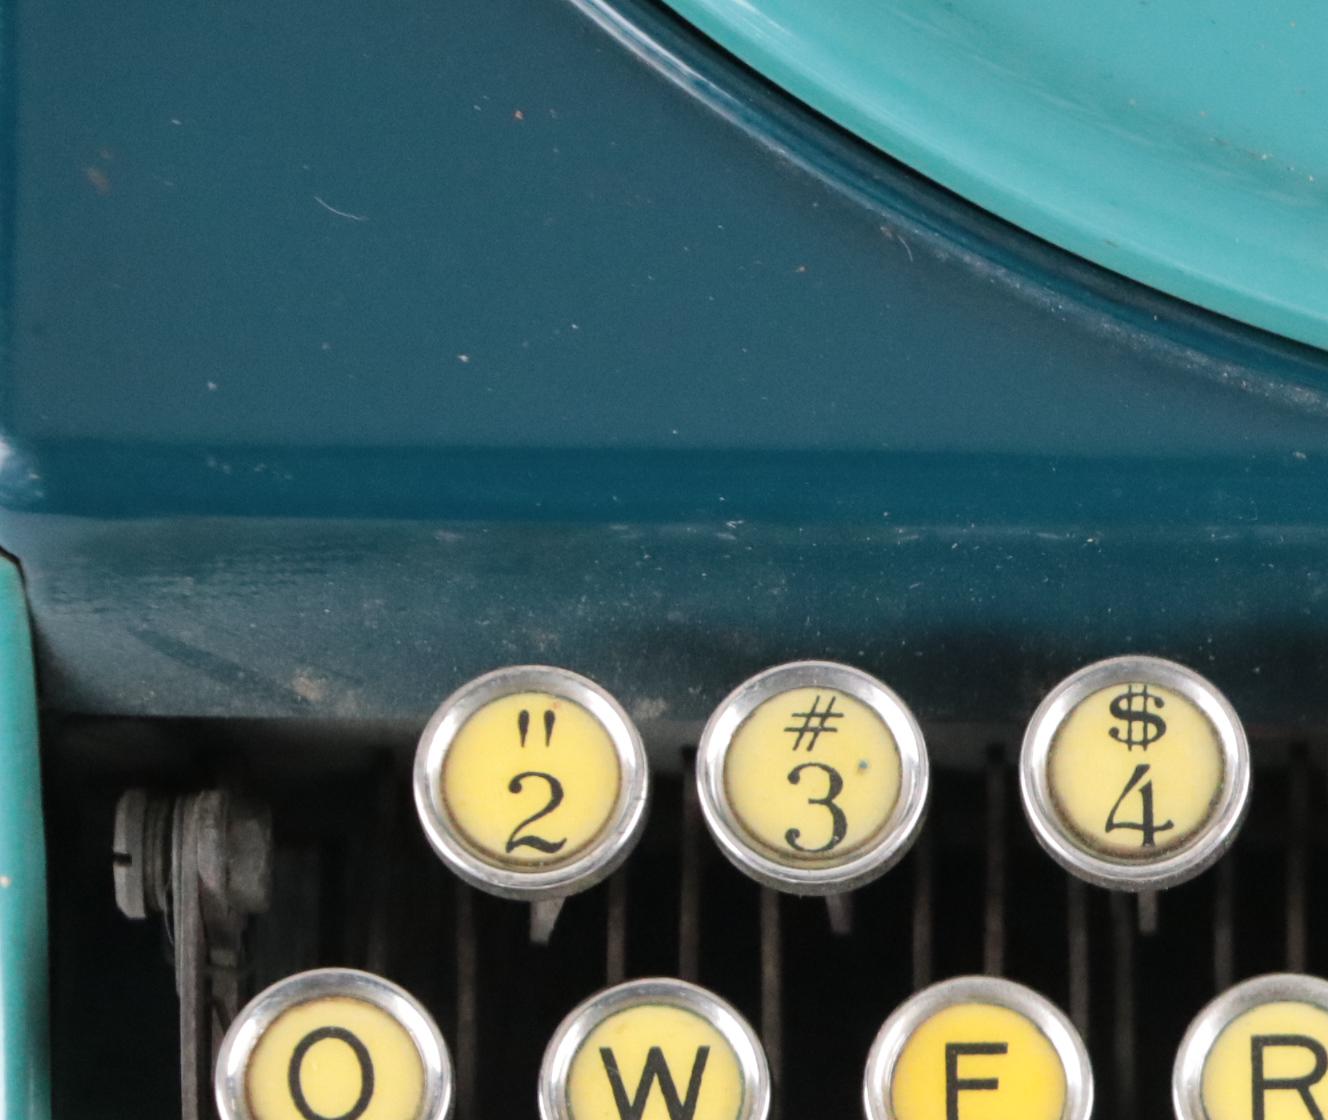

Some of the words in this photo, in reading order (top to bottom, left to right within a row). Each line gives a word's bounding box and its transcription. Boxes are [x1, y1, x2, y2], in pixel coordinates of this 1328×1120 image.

[784, 695, 845, 752] #
[1108, 683, 1167, 752] $
[505, 771, 567, 854] 2
[784, 763, 848, 855] 3
[1105, 764, 1174, 851] 4
